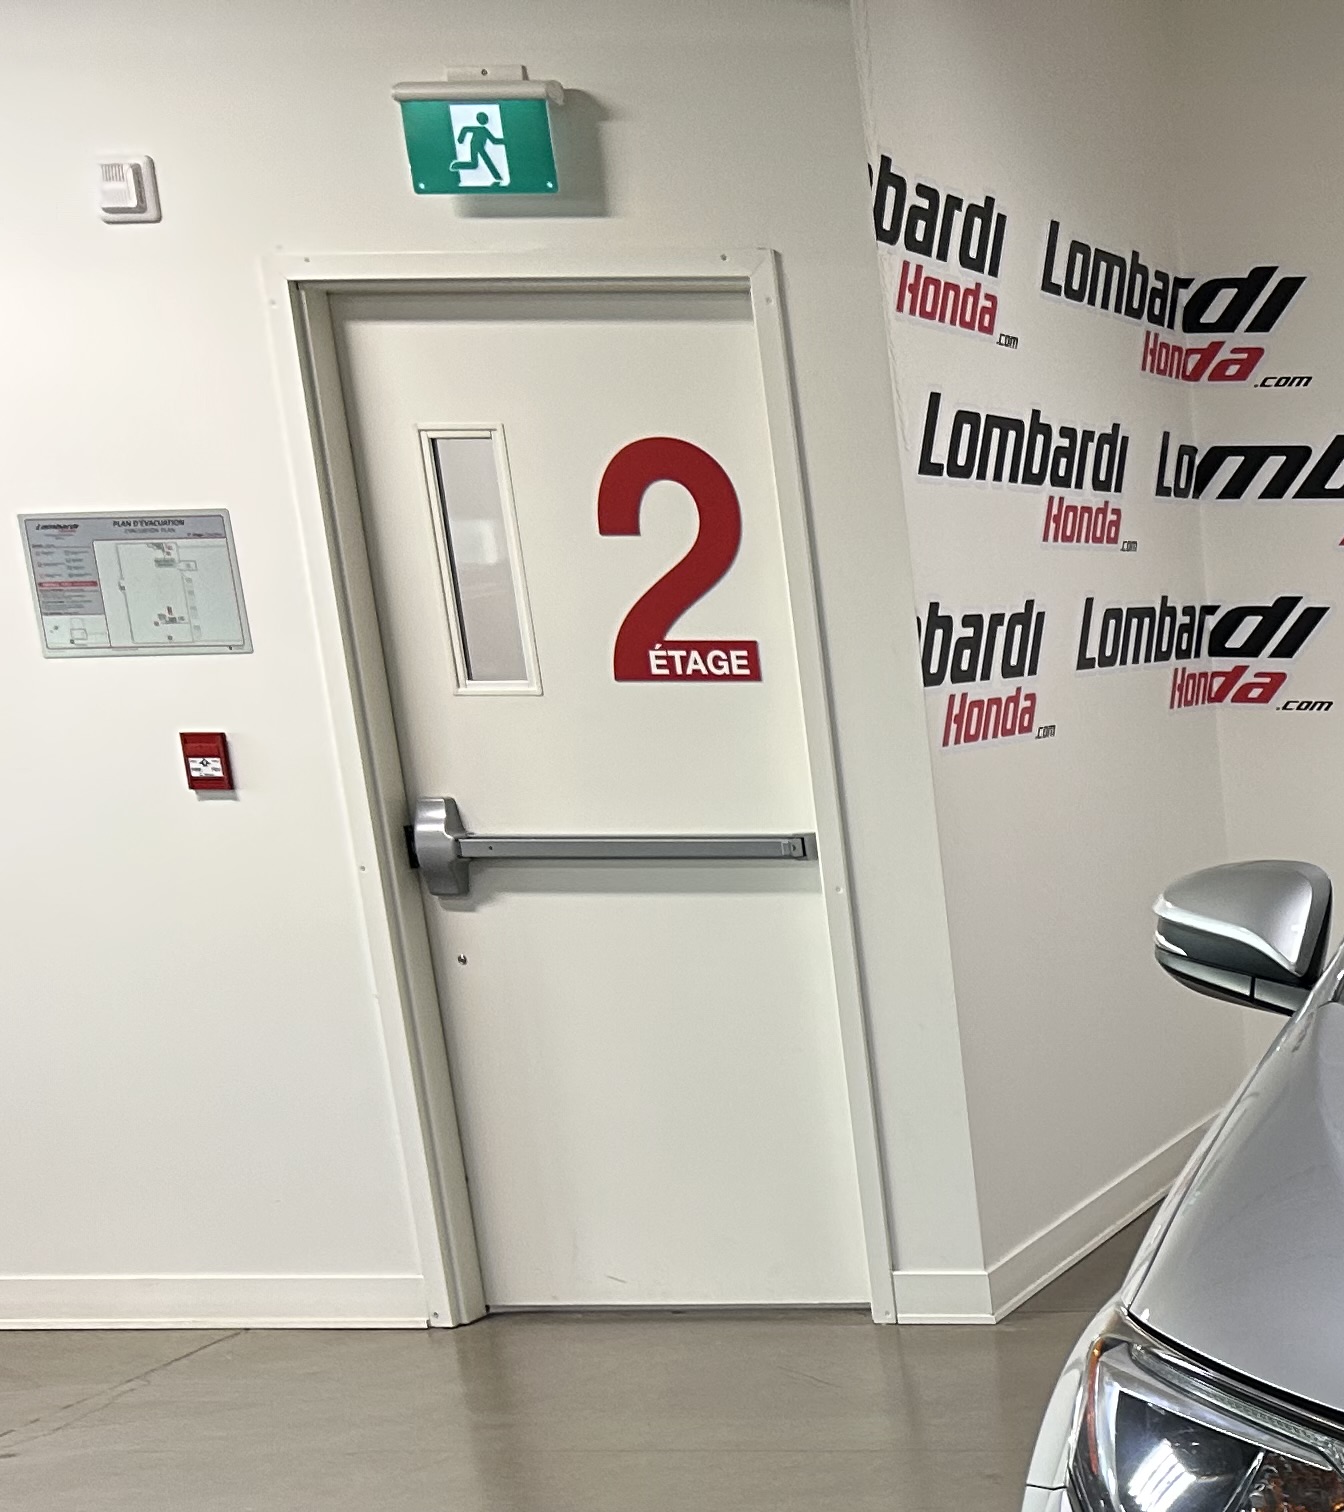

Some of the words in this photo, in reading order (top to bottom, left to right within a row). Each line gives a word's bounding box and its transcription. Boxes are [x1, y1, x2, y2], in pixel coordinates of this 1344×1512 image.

[868, 154, 1007, 278] bardi
[896, 260, 998, 335] Honda
[1040, 219, 1308, 333] Lombardi
[1142, 330, 1265, 382] Honda
[1253, 376, 1312, 388] .com
[917, 391, 1130, 493] Lombardi
[1042, 495, 1122, 544] Honda
[597, 436, 763, 682] 2
[649, 644, 751, 676] ÉTAGE
[916, 599, 1046, 688] bardi
[1075, 596, 1331, 671] Lombardi
[942, 687, 1037, 747] Honda
[1168, 666, 1287, 709] Honda
[1276, 700, 1334, 711] .com
